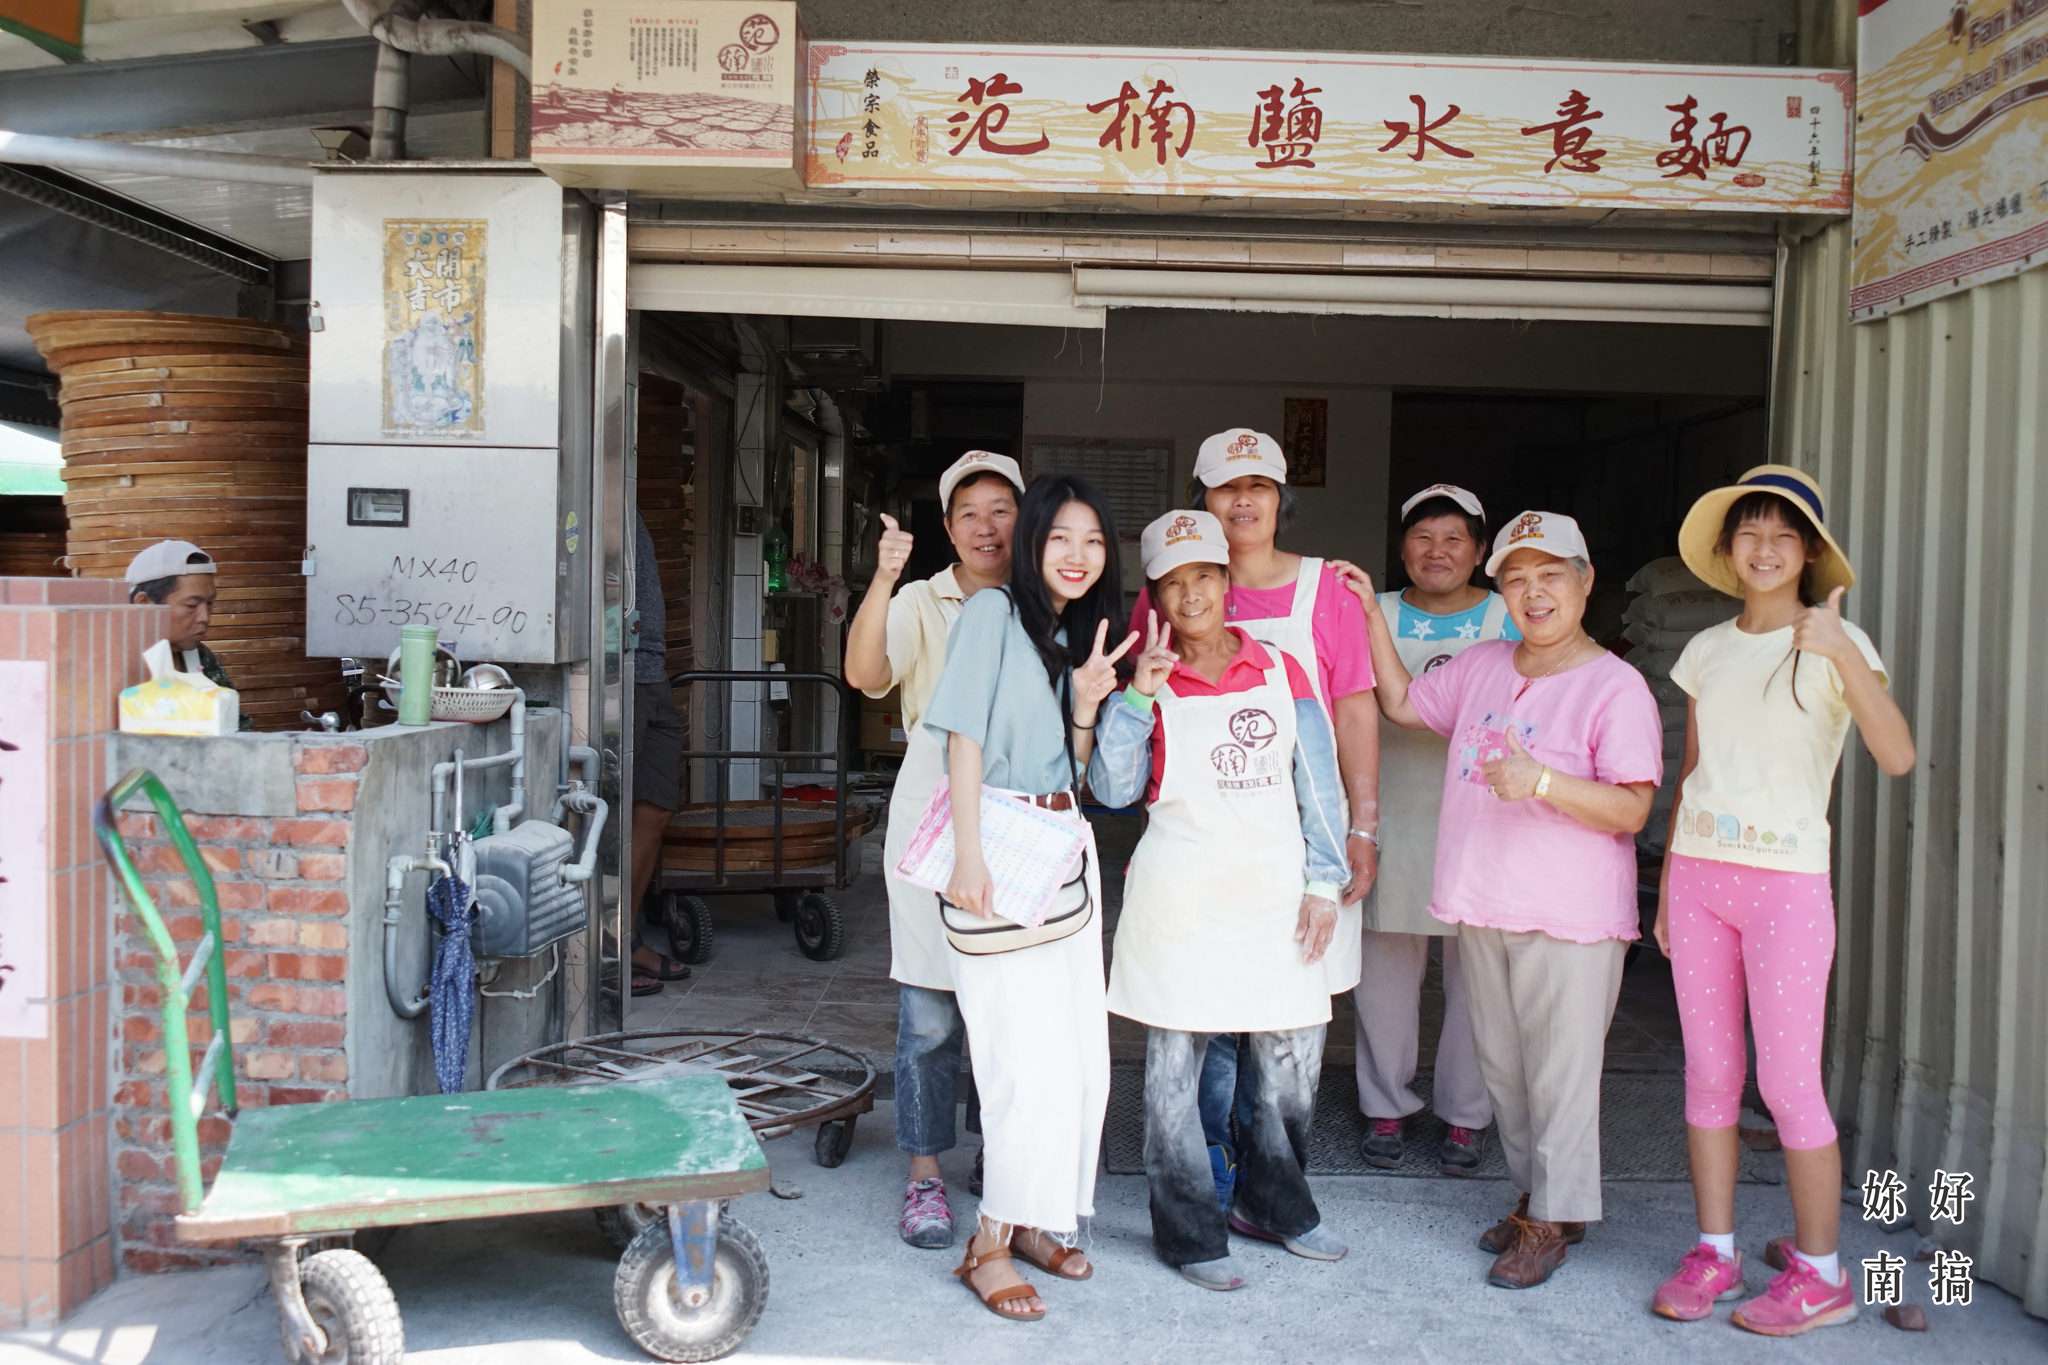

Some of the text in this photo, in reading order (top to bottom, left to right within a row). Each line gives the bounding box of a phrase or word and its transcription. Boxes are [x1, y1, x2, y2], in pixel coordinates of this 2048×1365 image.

[862, 66, 881, 159] 榮宗食品
[946, 72, 1753, 180] 范楠鹽水意麵
[391, 555, 479, 583] MX40
